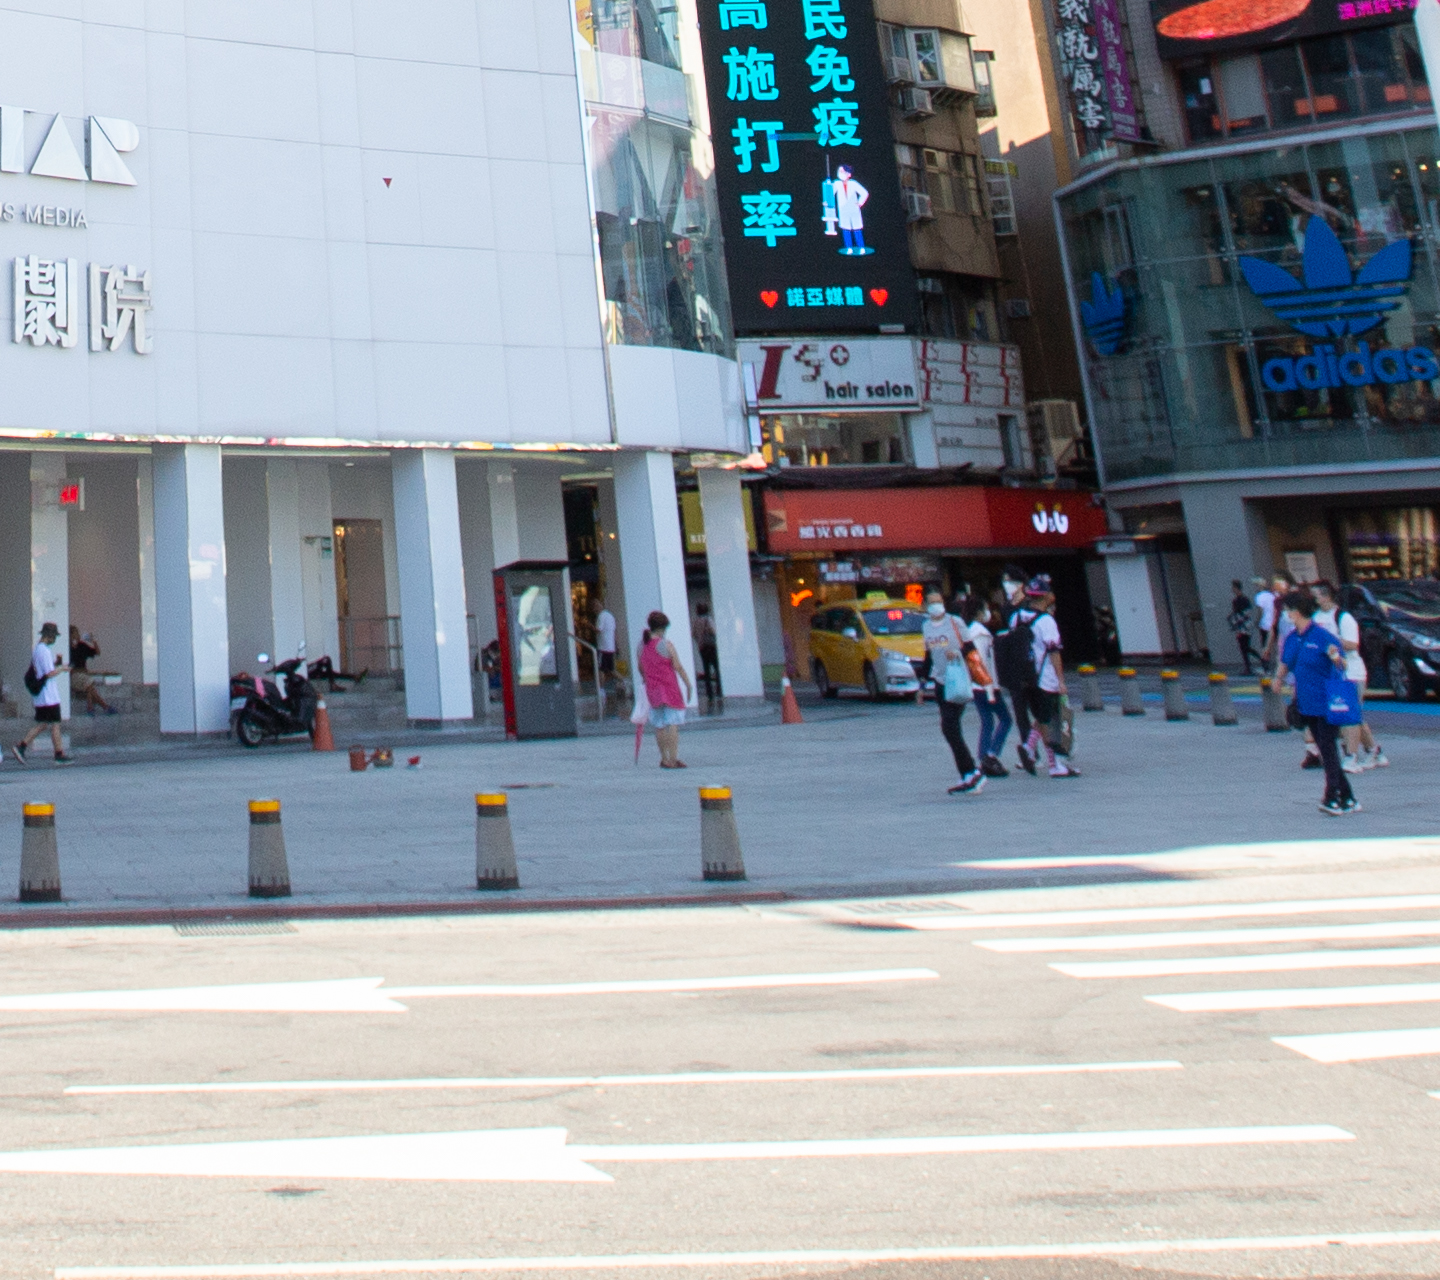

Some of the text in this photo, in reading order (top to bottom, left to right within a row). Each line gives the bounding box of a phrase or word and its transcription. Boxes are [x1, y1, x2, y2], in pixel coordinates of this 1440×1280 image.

[24, 203, 89, 229] MEDIA
[786, 286, 865, 308] 諾亞媒體
[1263, 342, 1440, 392] adidas
[824, 381, 915, 399] hair salon
